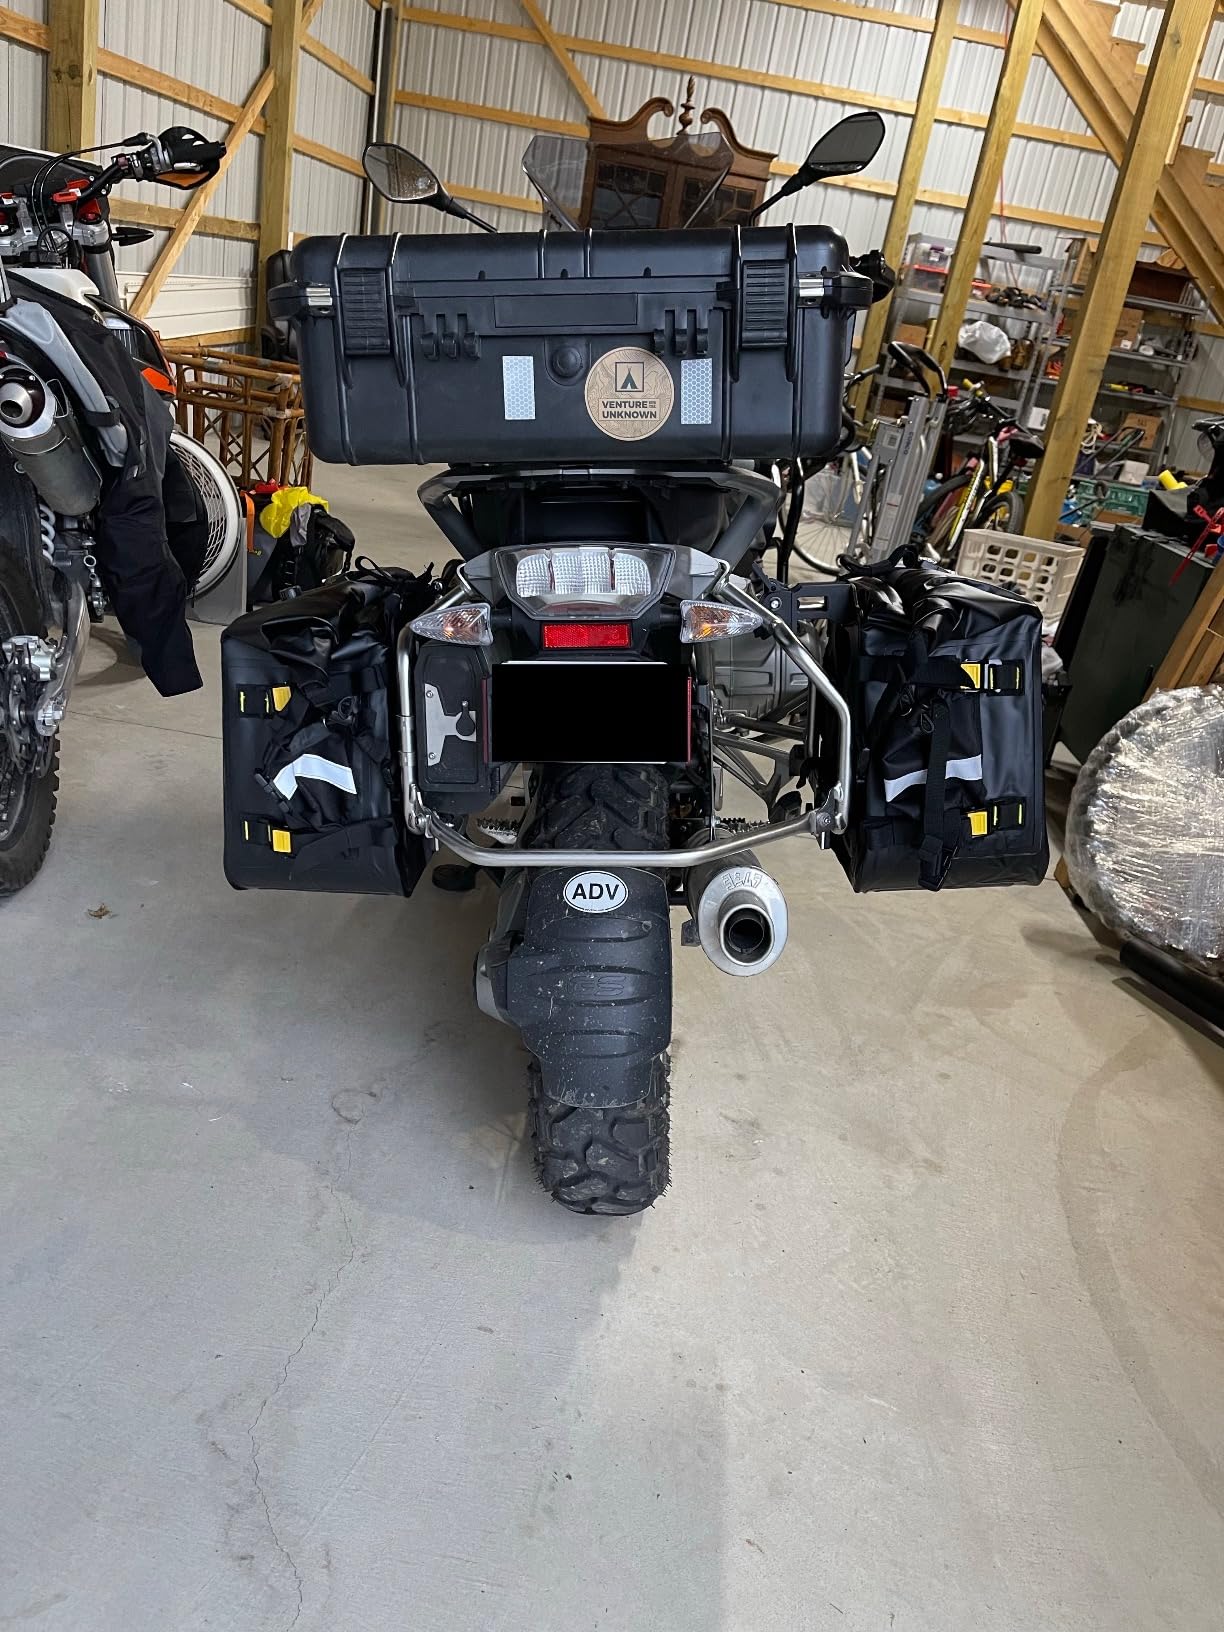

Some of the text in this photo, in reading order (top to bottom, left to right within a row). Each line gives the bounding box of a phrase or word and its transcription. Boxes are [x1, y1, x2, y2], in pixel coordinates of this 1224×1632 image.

[602, 401, 648, 409] VENTURE
[602, 411, 657, 419] UNKNOWN
[571, 883, 620, 900] ADV
